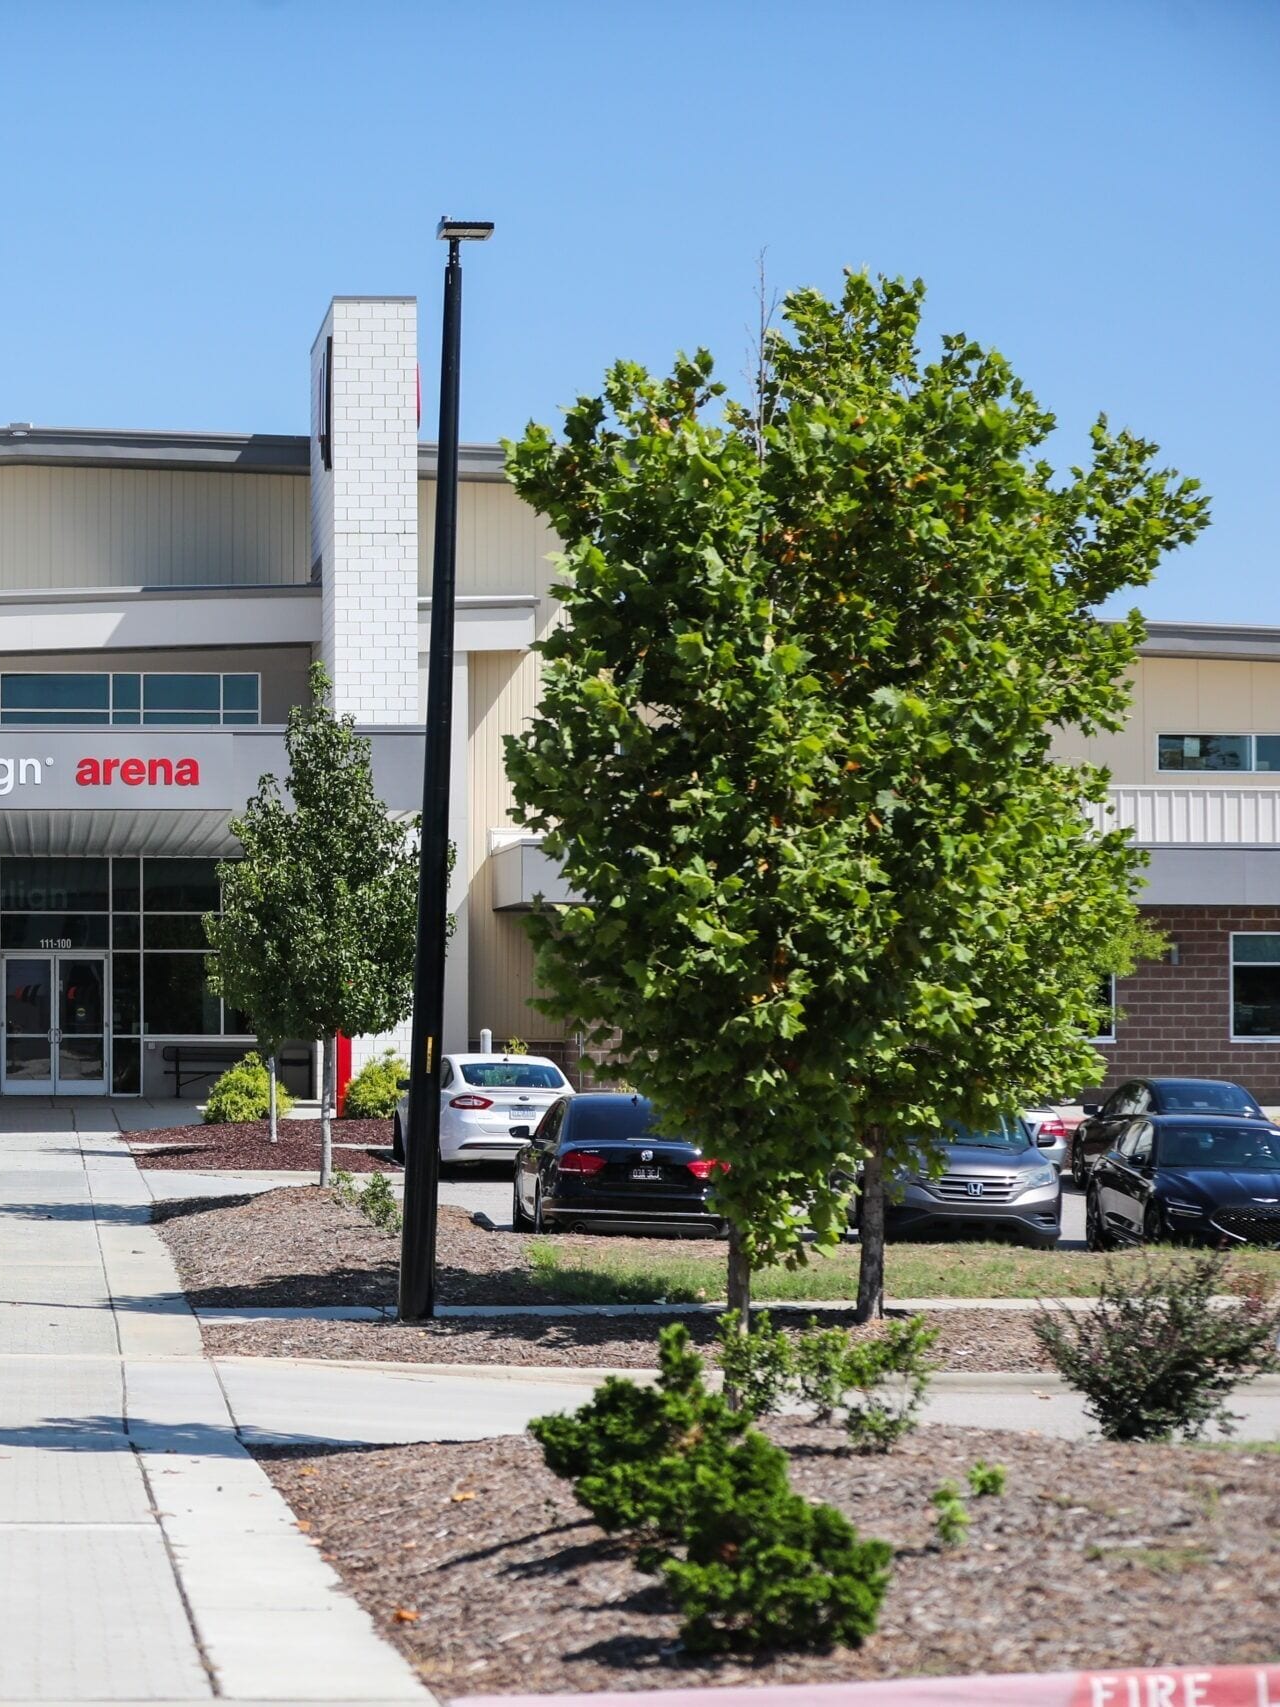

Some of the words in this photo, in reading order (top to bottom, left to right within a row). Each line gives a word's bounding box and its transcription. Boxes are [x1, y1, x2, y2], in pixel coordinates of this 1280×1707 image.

[76, 758, 200, 787] arena
[39, 938, 72, 949] 111-100
[1089, 1671, 1214, 1707] FIRE
